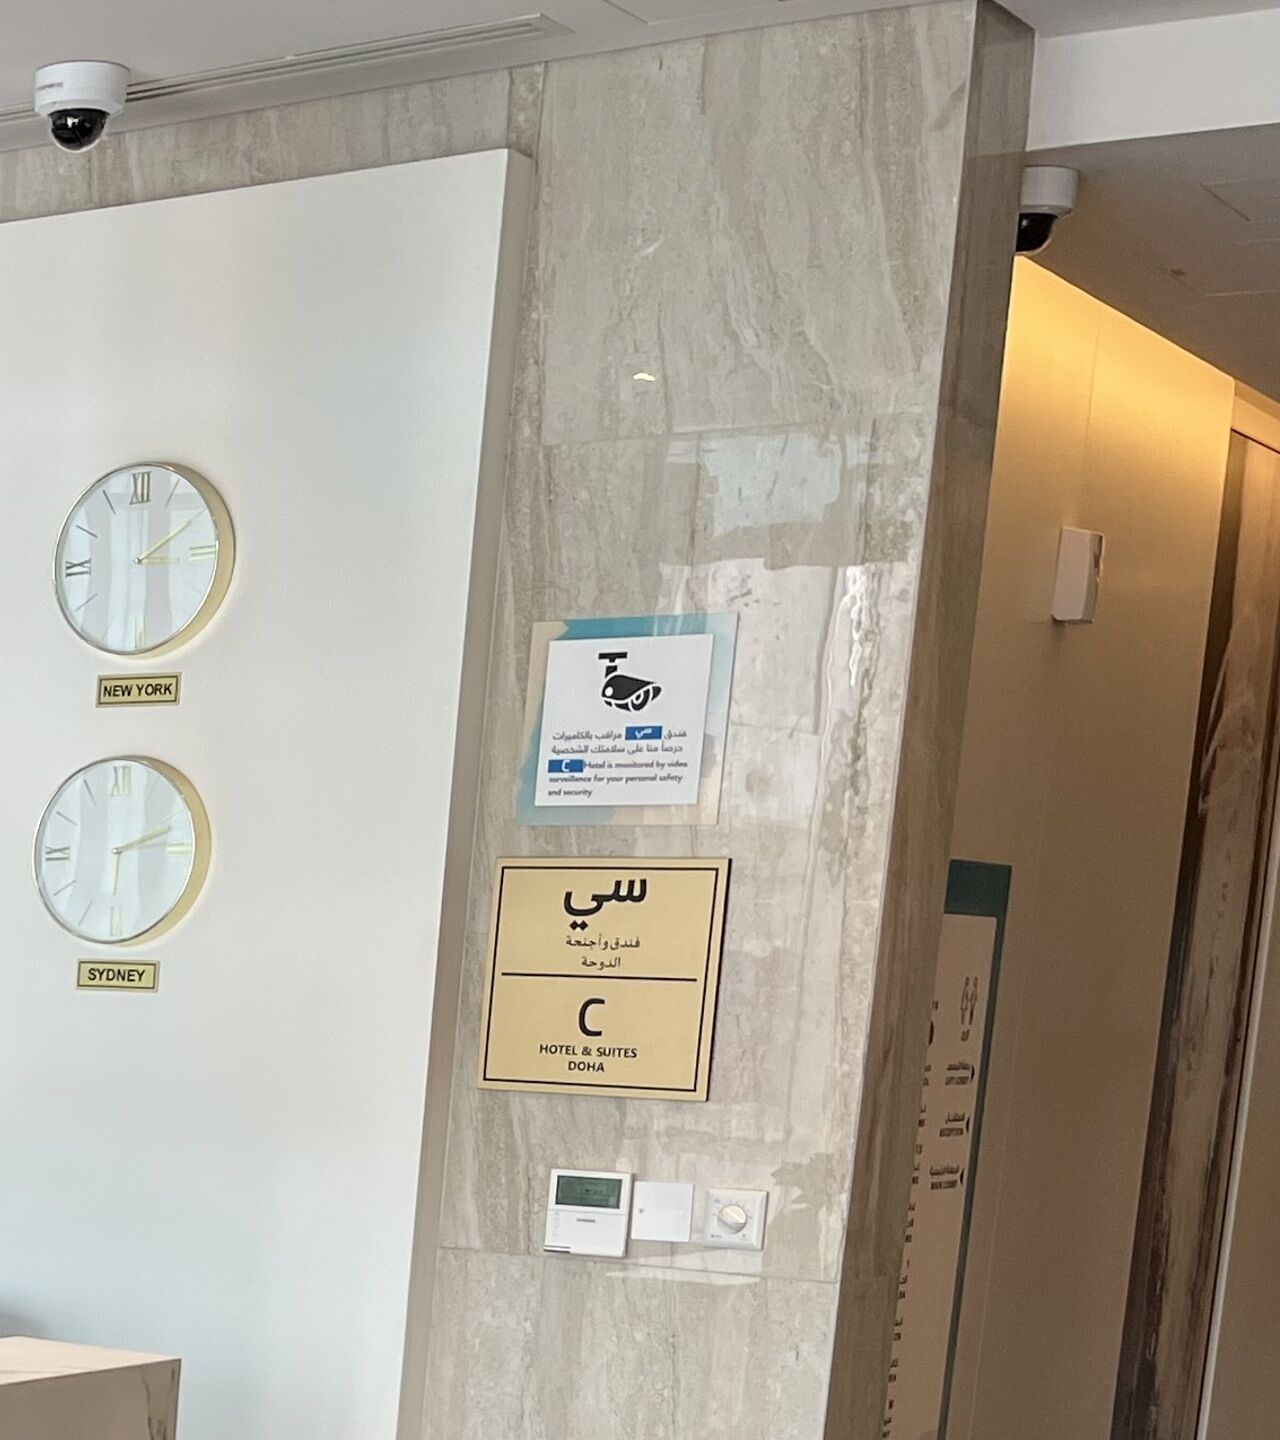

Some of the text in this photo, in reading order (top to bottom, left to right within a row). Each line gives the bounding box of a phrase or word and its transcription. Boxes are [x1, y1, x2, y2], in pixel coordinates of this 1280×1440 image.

[129, 471, 152, 505] XII
[103, 683, 173, 697] NEW YORK
[561, 760, 570, 772] C
[615, 760, 654, 769] monitored
[656, 761, 665, 771] by
[667, 760, 688, 768] video
[593, 774, 605, 782] for
[607, 776, 624, 784] your
[625, 774, 657, 784] personal
[659, 773, 683, 784] safety
[548, 788, 593, 798] and security
[563, 878, 648, 931] سي
[610, 936, 641, 951] فندق
[581, 956, 622, 971] الدوحة
[87, 968, 146, 983] SYDNEY
[578, 998, 606, 1037] C
[539, 1043, 638, 1059] HOTEL & SUITES
[567, 1061, 606, 1073] DOHA
